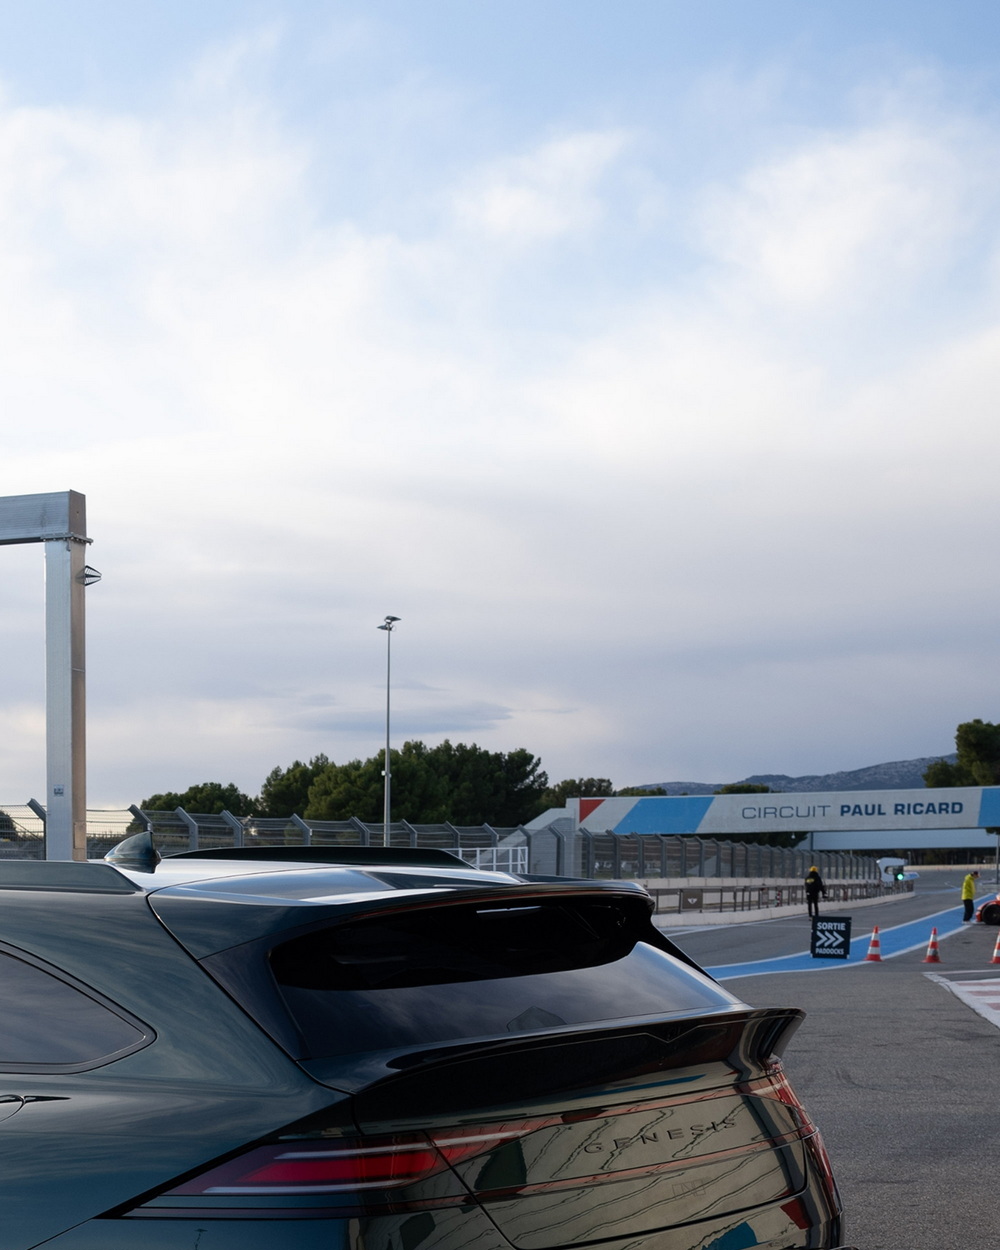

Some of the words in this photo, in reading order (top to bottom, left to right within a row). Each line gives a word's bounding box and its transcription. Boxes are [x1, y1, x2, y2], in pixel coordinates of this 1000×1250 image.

[741, 805, 831, 820] CIRCUIT
[840, 804, 886, 816] PAUL
[893, 802, 964, 815] RICARD
[817, 922, 846, 930] SORTIE
[584, 1118, 737, 1154] GENESIS
